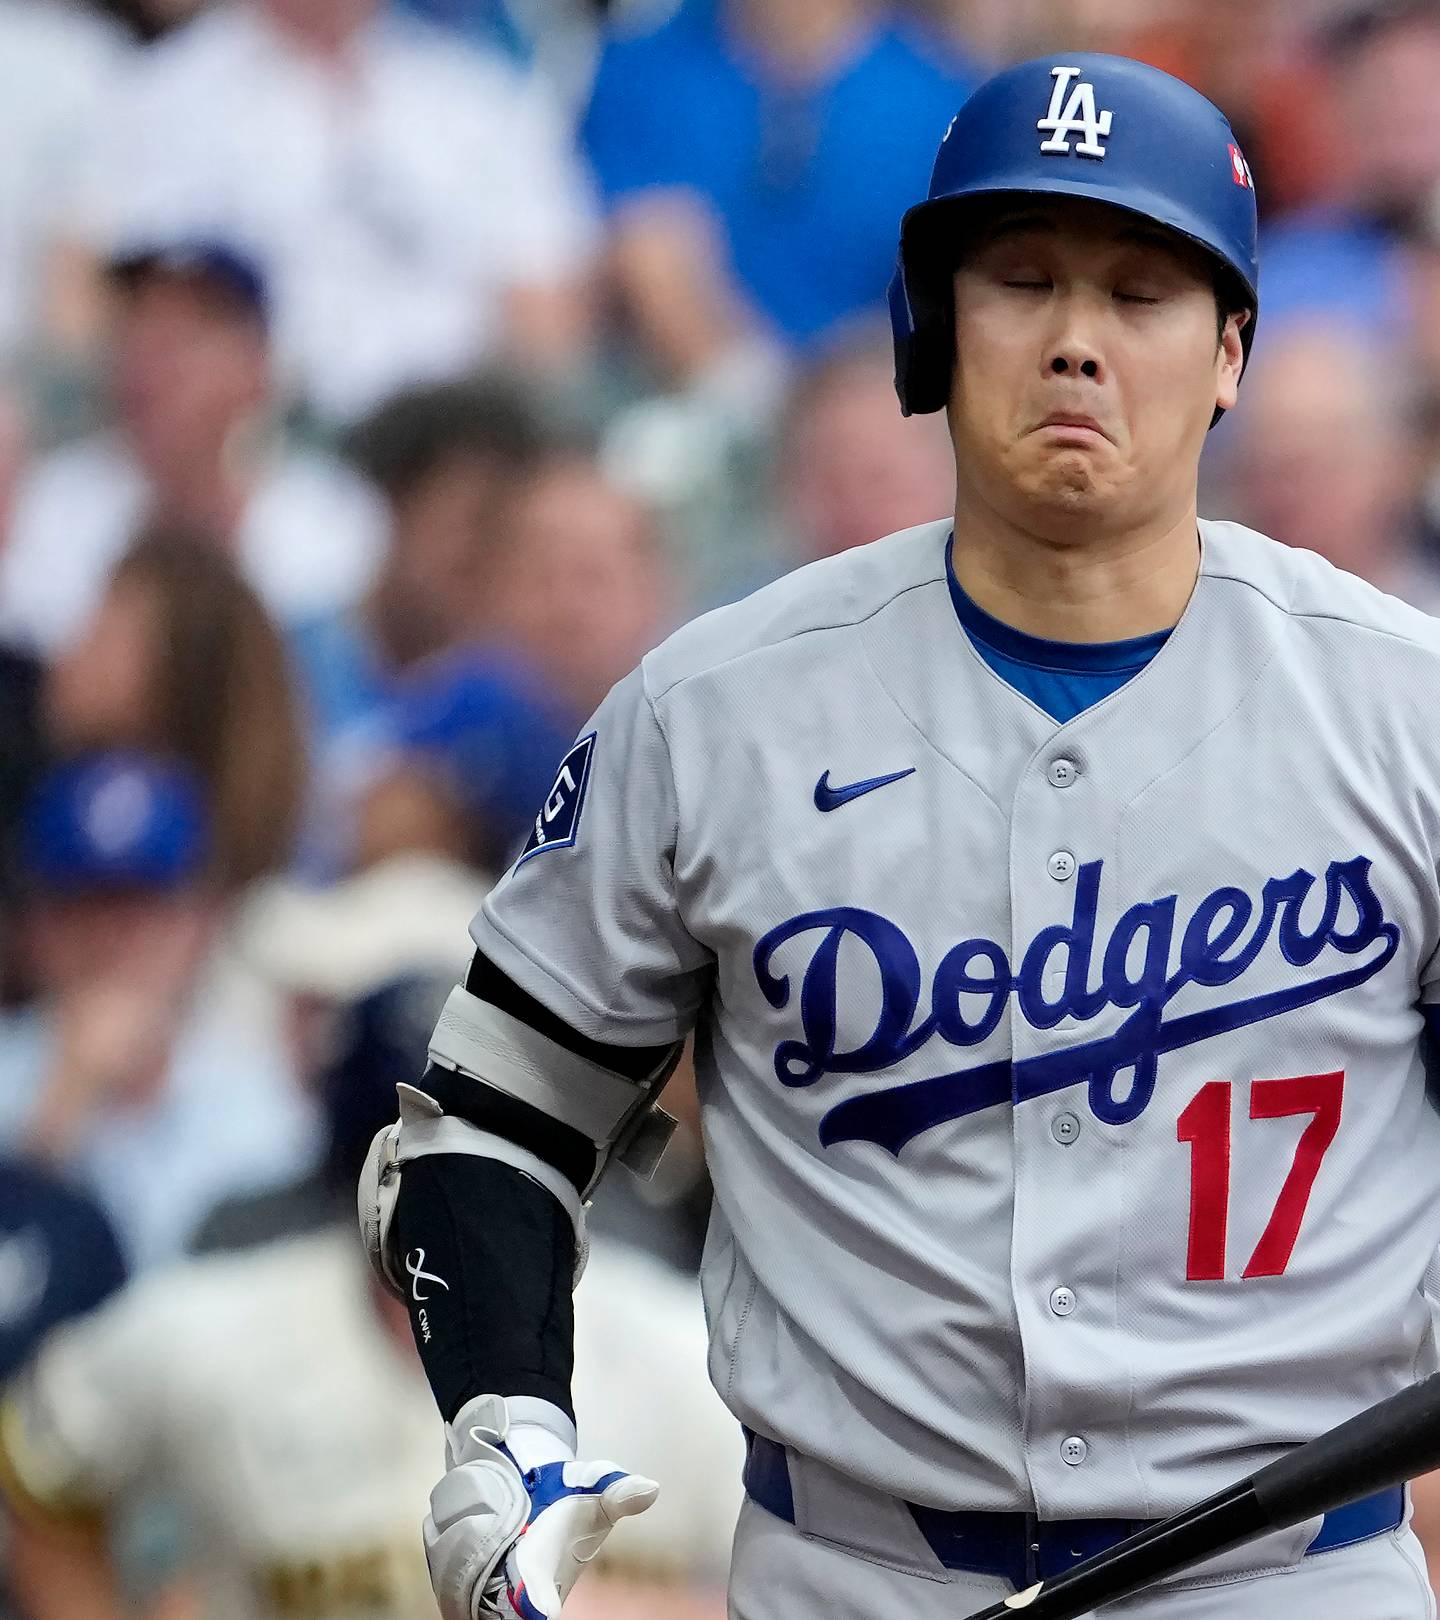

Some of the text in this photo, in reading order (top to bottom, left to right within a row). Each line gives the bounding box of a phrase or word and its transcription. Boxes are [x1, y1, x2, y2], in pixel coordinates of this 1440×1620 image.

[1037, 66, 1114, 158] LA
[753, 855, 1400, 1126] Dodgers
[1176, 1070, 1345, 1282] 17
